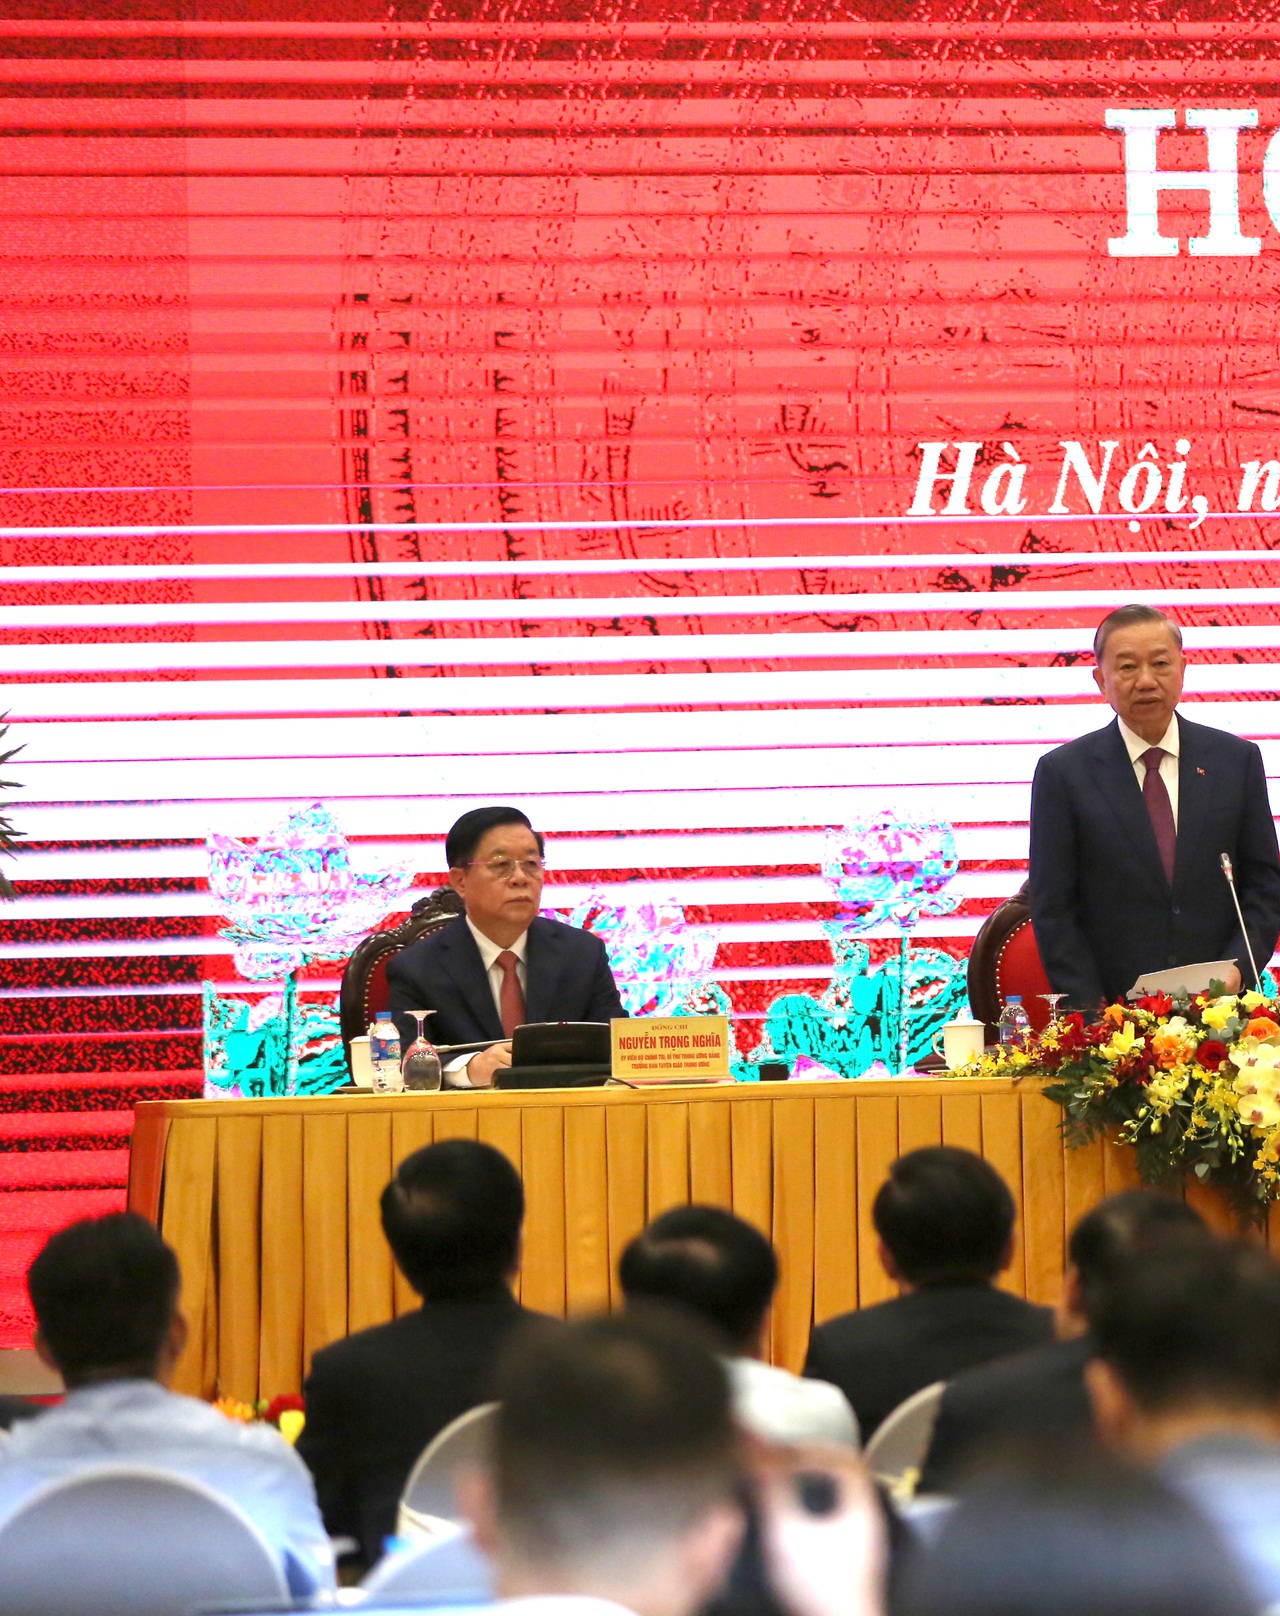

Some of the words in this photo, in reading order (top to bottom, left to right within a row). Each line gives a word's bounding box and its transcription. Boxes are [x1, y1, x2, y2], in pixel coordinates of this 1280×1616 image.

[906, 440, 1027, 516] Hà
[1051, 438, 1210, 533] Nội,
[619, 1031, 657, 1050] NGUYỄN
[659, 1035, 690, 1051] TRỌNG
[692, 1032, 721, 1047] NGHĨA
